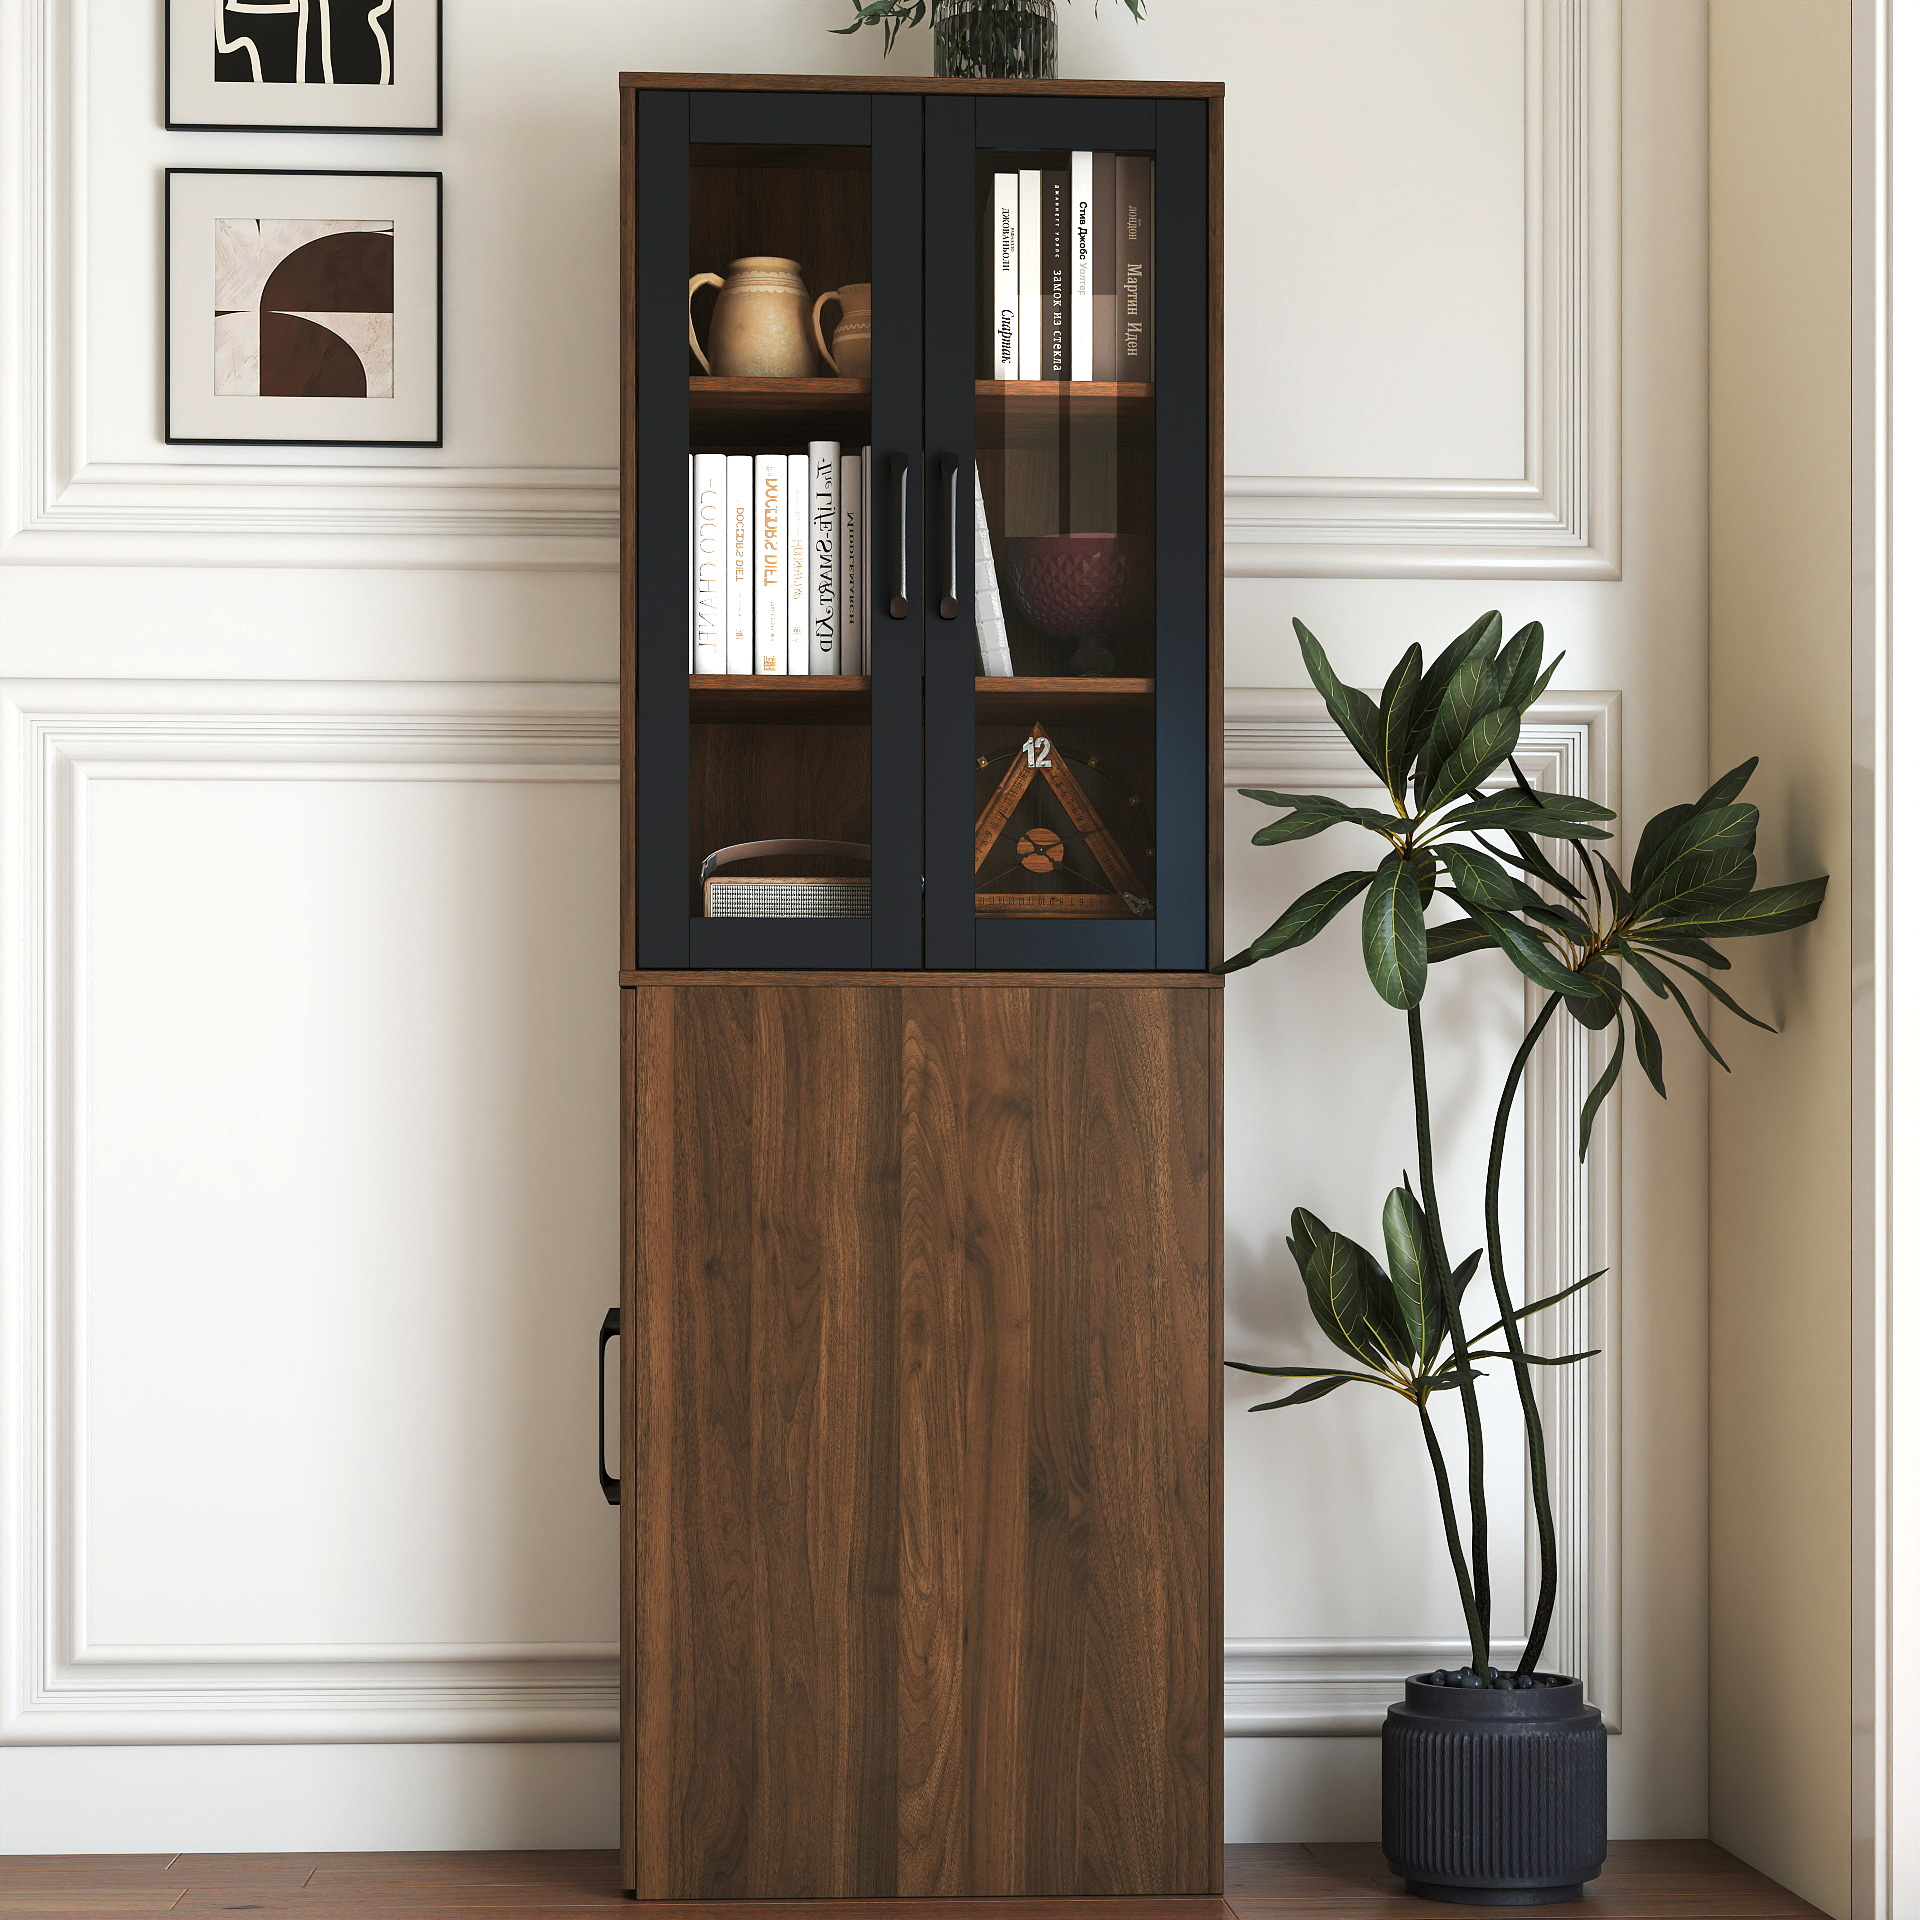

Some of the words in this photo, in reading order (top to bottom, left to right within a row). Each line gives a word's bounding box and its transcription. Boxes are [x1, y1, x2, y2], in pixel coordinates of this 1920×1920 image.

[1079, 202, 1088, 225] Стив
[1001, 207, 1010, 271] ДЖОВАНЬОЛИ
[1078, 227, 1088, 260] Джобс
[1078, 262, 1088, 296] Уолтер
[1124, 264, 1142, 316] Мартин
[1053, 312, 1062, 326] из
[998, 309, 1014, 364] Спартак
[1053, 331, 1062, 372] стекла
[1125, 322, 1142, 356] Иден
[1022, 736, 1052, 768] 12
[1123, 891, 1154, 917] 4
